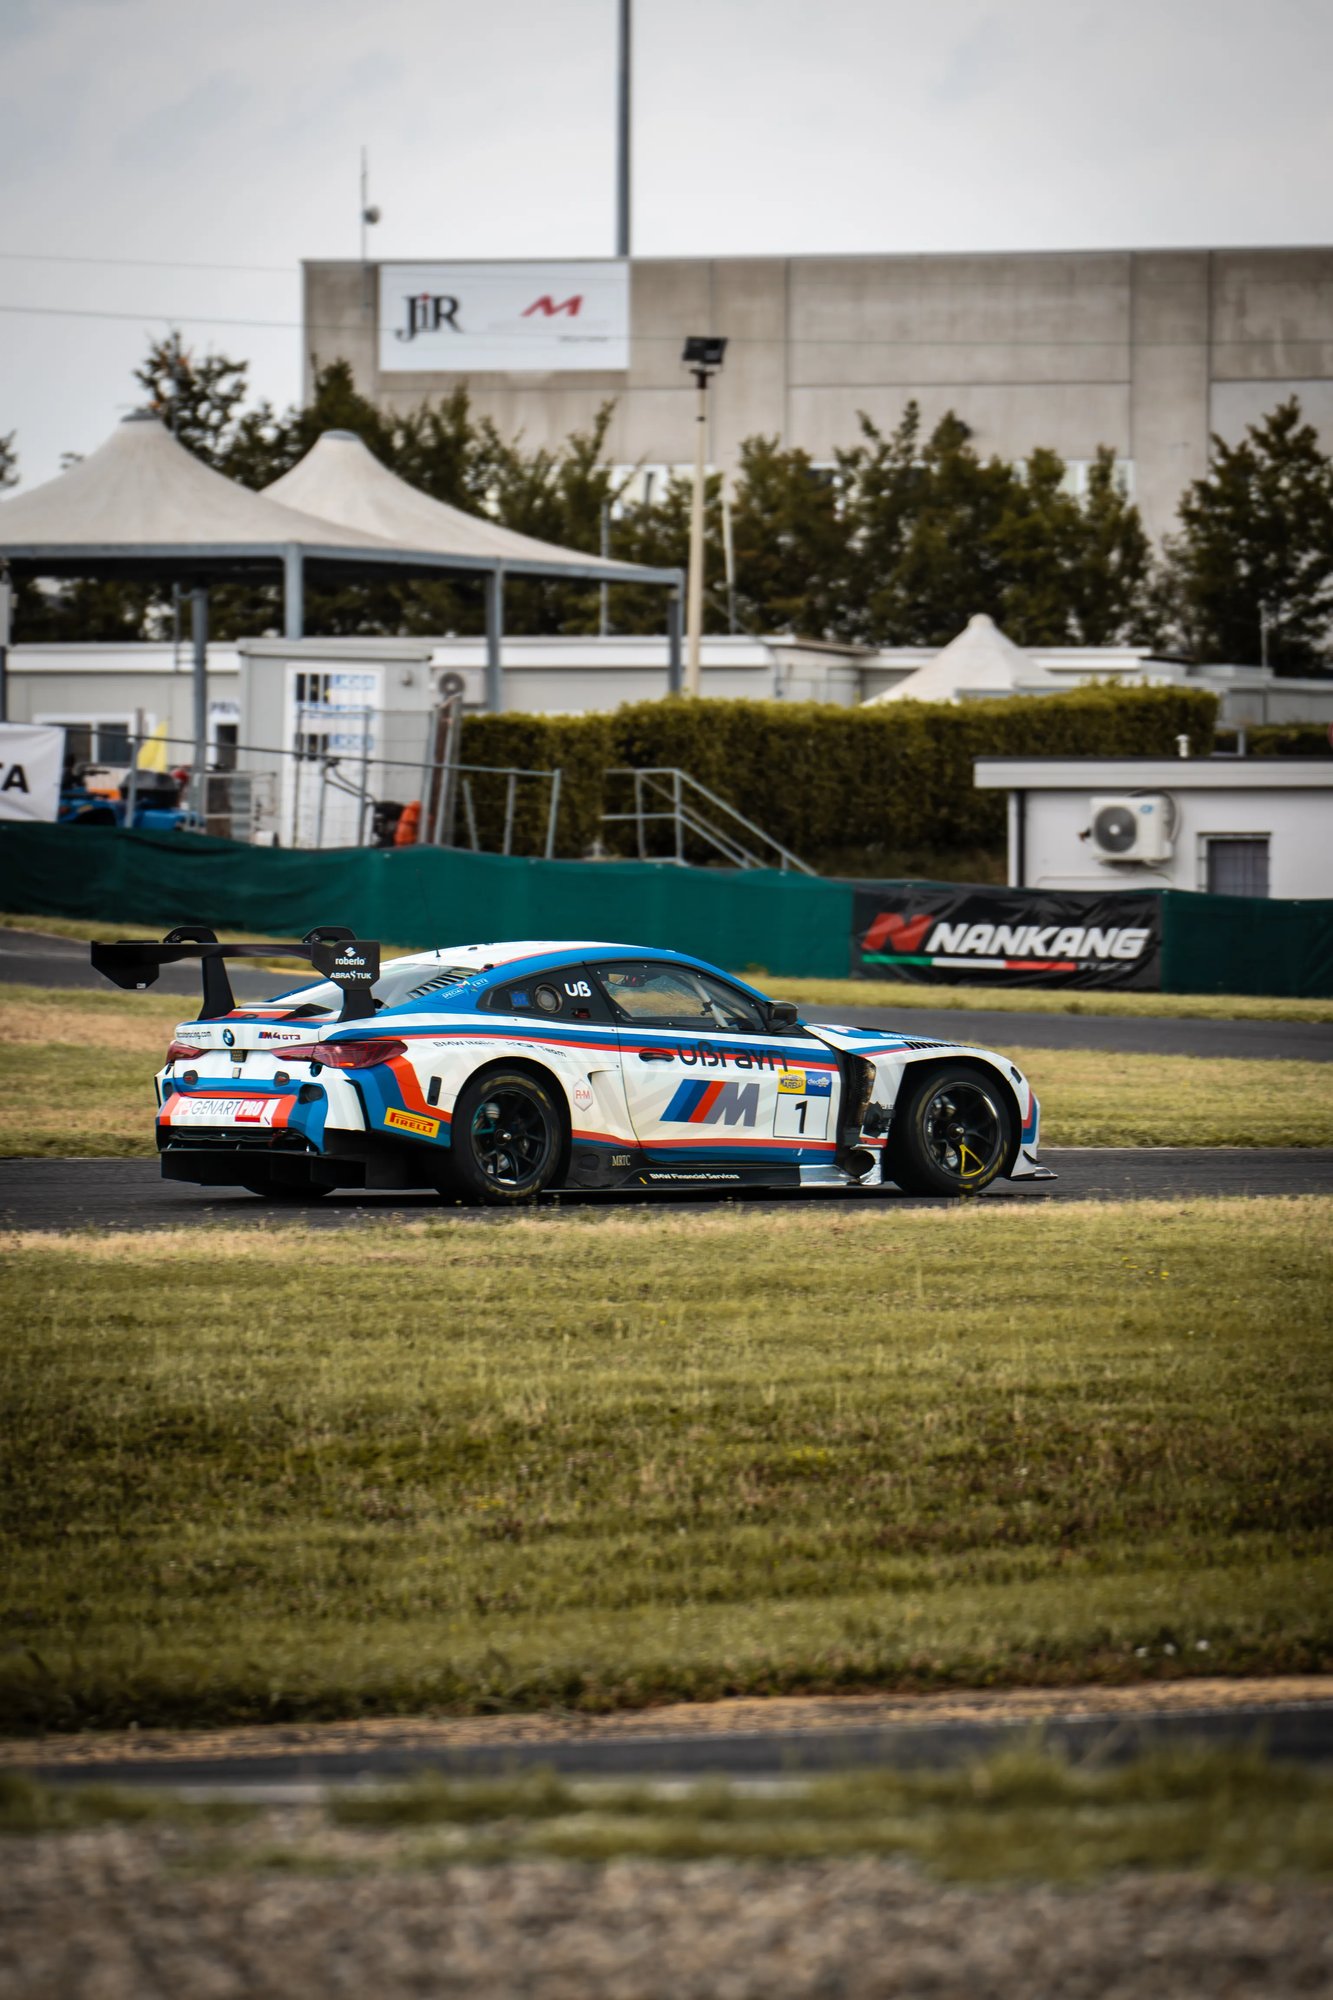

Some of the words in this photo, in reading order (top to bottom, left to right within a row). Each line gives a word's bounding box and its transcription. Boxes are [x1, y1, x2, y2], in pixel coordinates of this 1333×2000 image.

[0, 762, 30, 794] A
[924, 923, 1151, 959] NANKANG
[335, 957, 366, 966] roberlo
[191, 1100, 240, 1115] GENART
[238, 1100, 265, 1116] PRO
[795, 1100, 808, 1134] 1
[390, 1112, 434, 1133] PIRELLI
